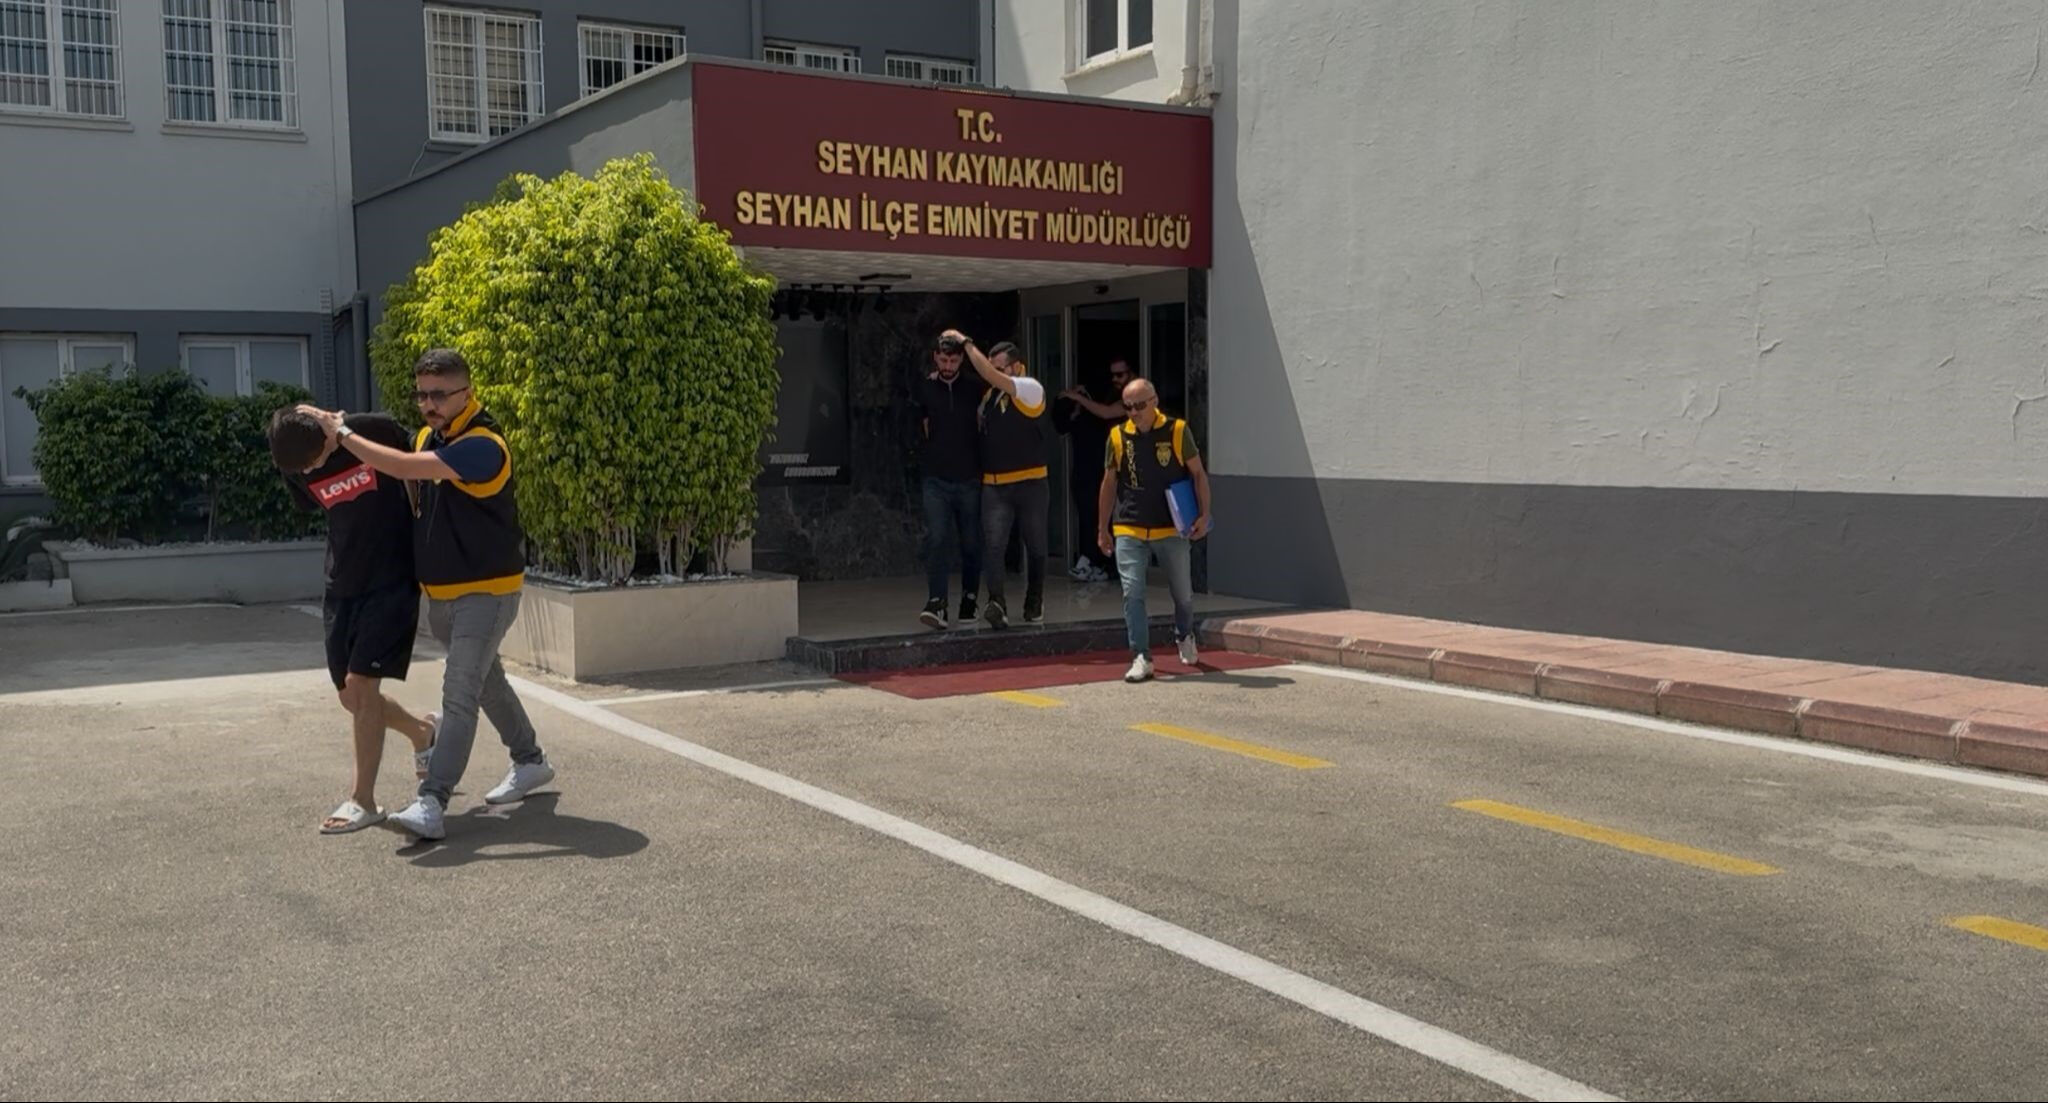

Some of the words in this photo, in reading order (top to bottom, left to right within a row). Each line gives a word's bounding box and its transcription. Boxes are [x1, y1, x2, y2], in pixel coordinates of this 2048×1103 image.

[957, 108, 1002, 143] T.C.
[818, 140, 928, 181] SEYHAN
[936, 150, 1123, 195] KAYMAKAMLIĞI
[736, 190, 852, 231] SEYHAN
[861, 192, 920, 241] İLÇE
[927, 200, 1039, 241] EMNİYET
[1046, 206, 1191, 249] MÜDÜRLÜĞÜ
